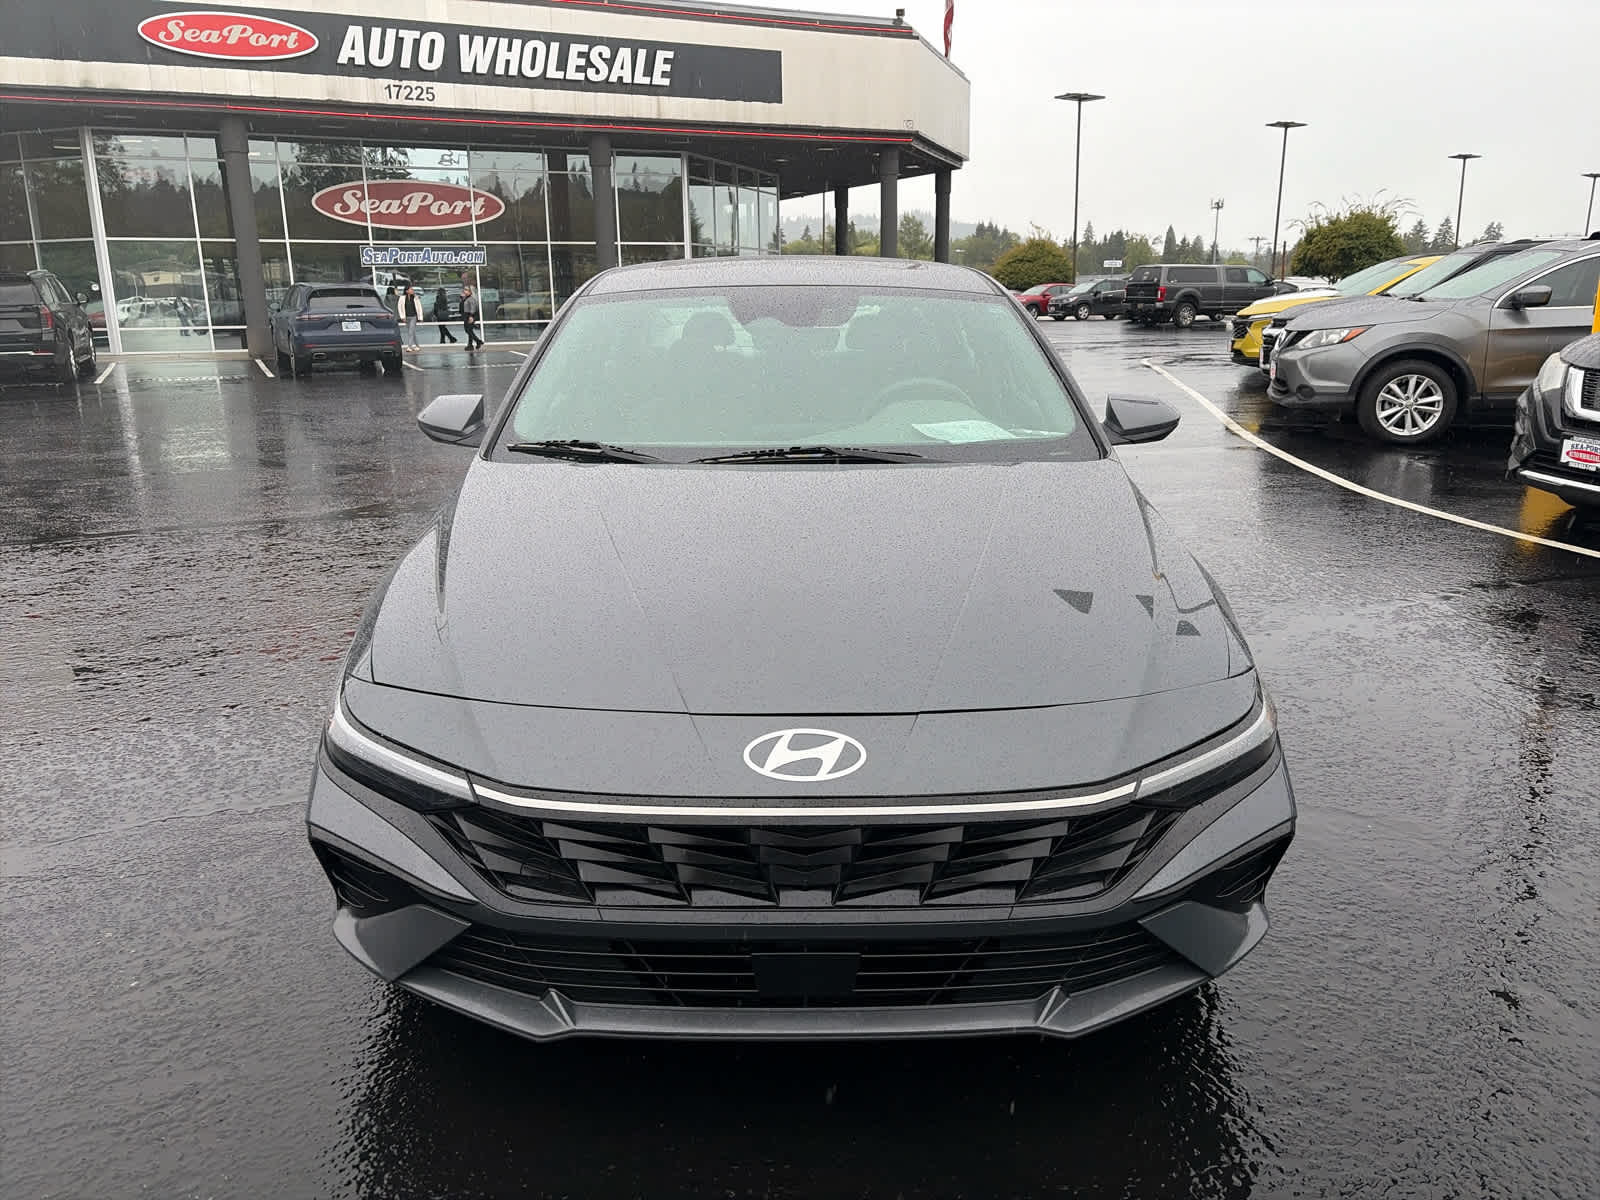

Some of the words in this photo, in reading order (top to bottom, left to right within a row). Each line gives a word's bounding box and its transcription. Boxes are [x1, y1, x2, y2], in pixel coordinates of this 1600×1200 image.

[159, 19, 299, 49] SeaPort
[337, 25, 446, 71] AUTO
[459, 34, 675, 86] WHOLESALE
[384, 84, 436, 102] 17225
[333, 190, 486, 216] SeaPort
